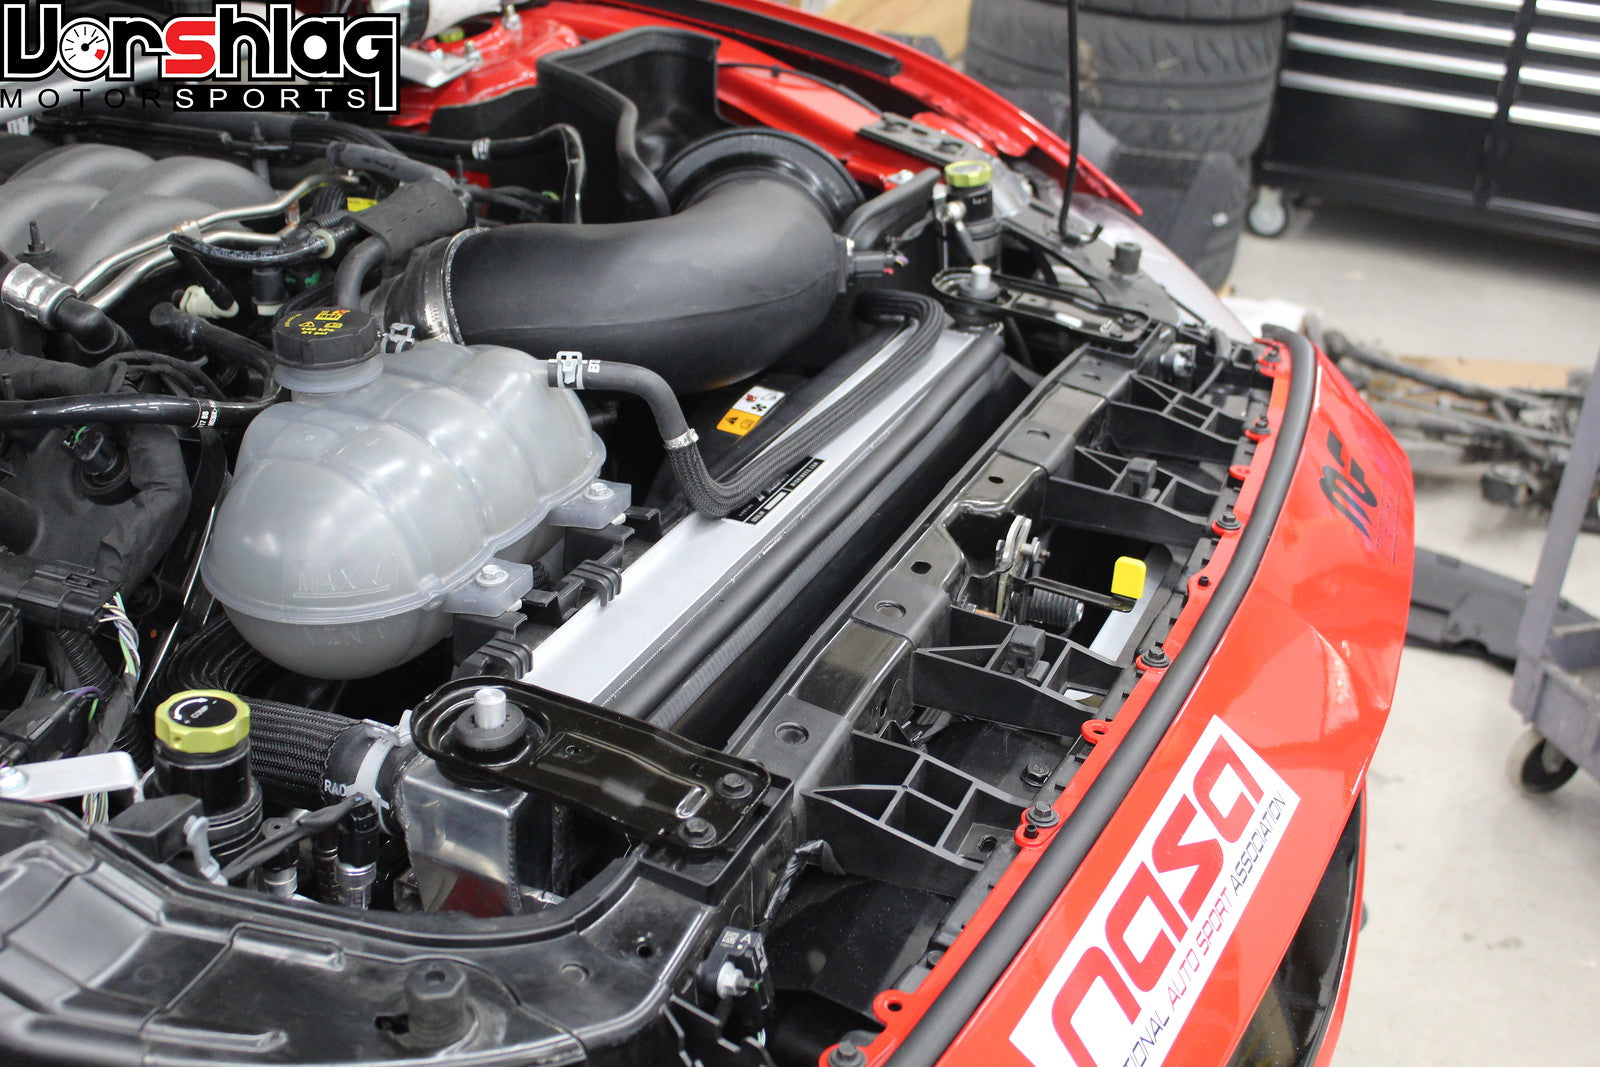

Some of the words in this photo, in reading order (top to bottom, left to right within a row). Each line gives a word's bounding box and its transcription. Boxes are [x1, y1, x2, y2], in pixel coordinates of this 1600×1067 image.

[1167, 948, 1200, 1011] AUTO
[1196, 887, 1233, 956] SPORT
[1230, 789, 1286, 896] ASSOCIATION
